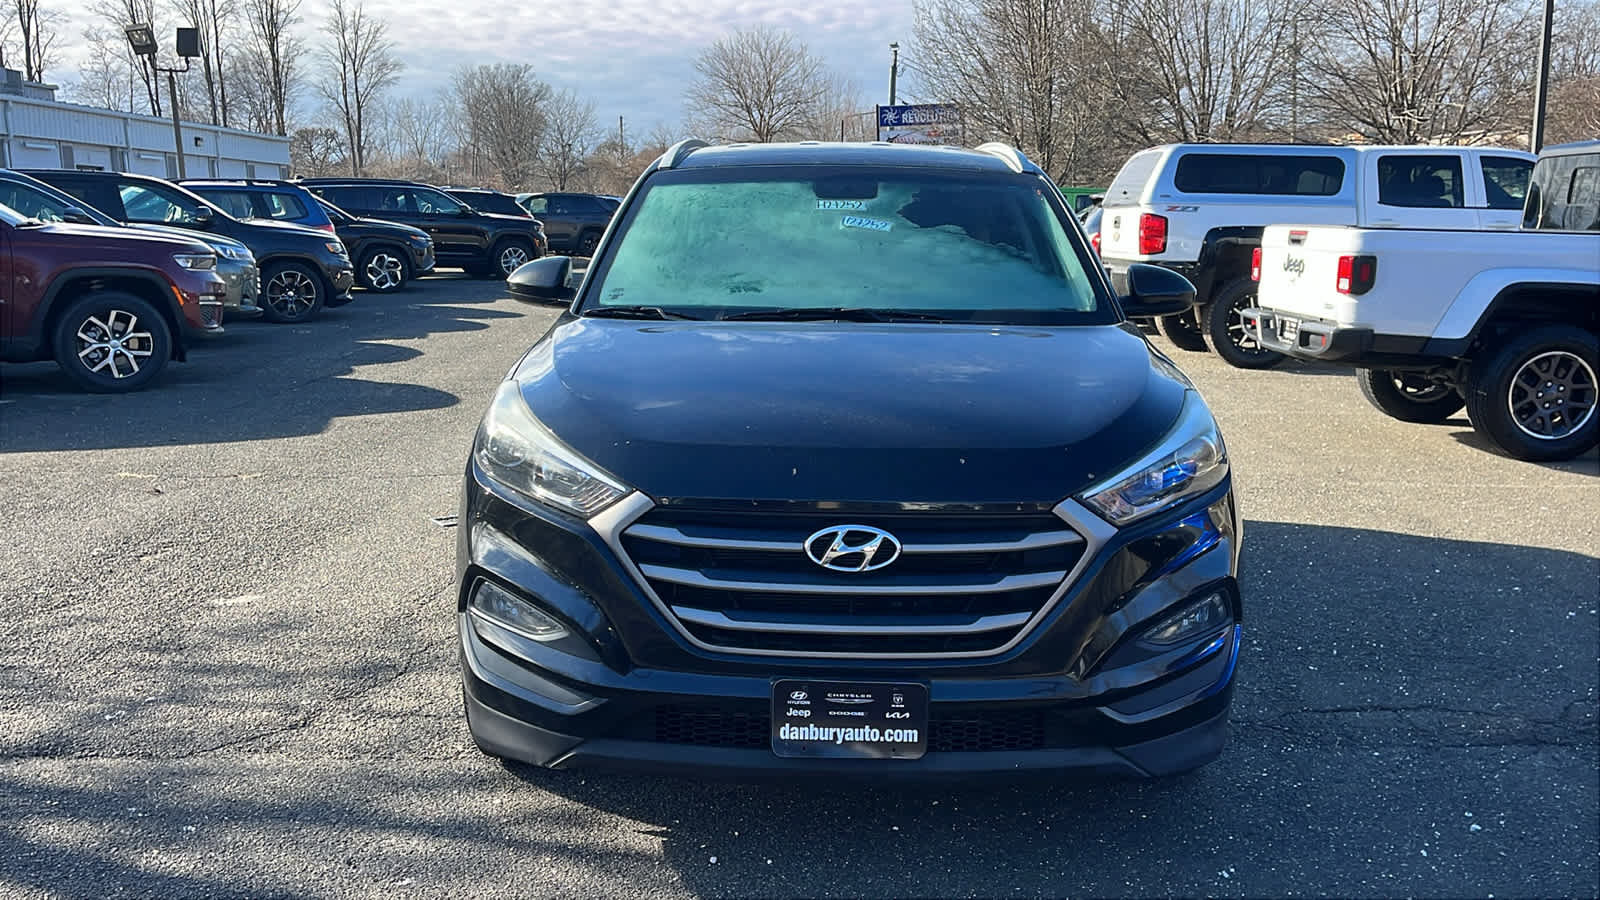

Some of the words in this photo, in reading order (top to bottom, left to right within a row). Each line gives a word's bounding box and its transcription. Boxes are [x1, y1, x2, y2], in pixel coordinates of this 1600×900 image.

[1283, 253, 1305, 277] Jeep
[786, 708, 811, 718] Jeep
[780, 723, 919, 745] danburyauto.com
